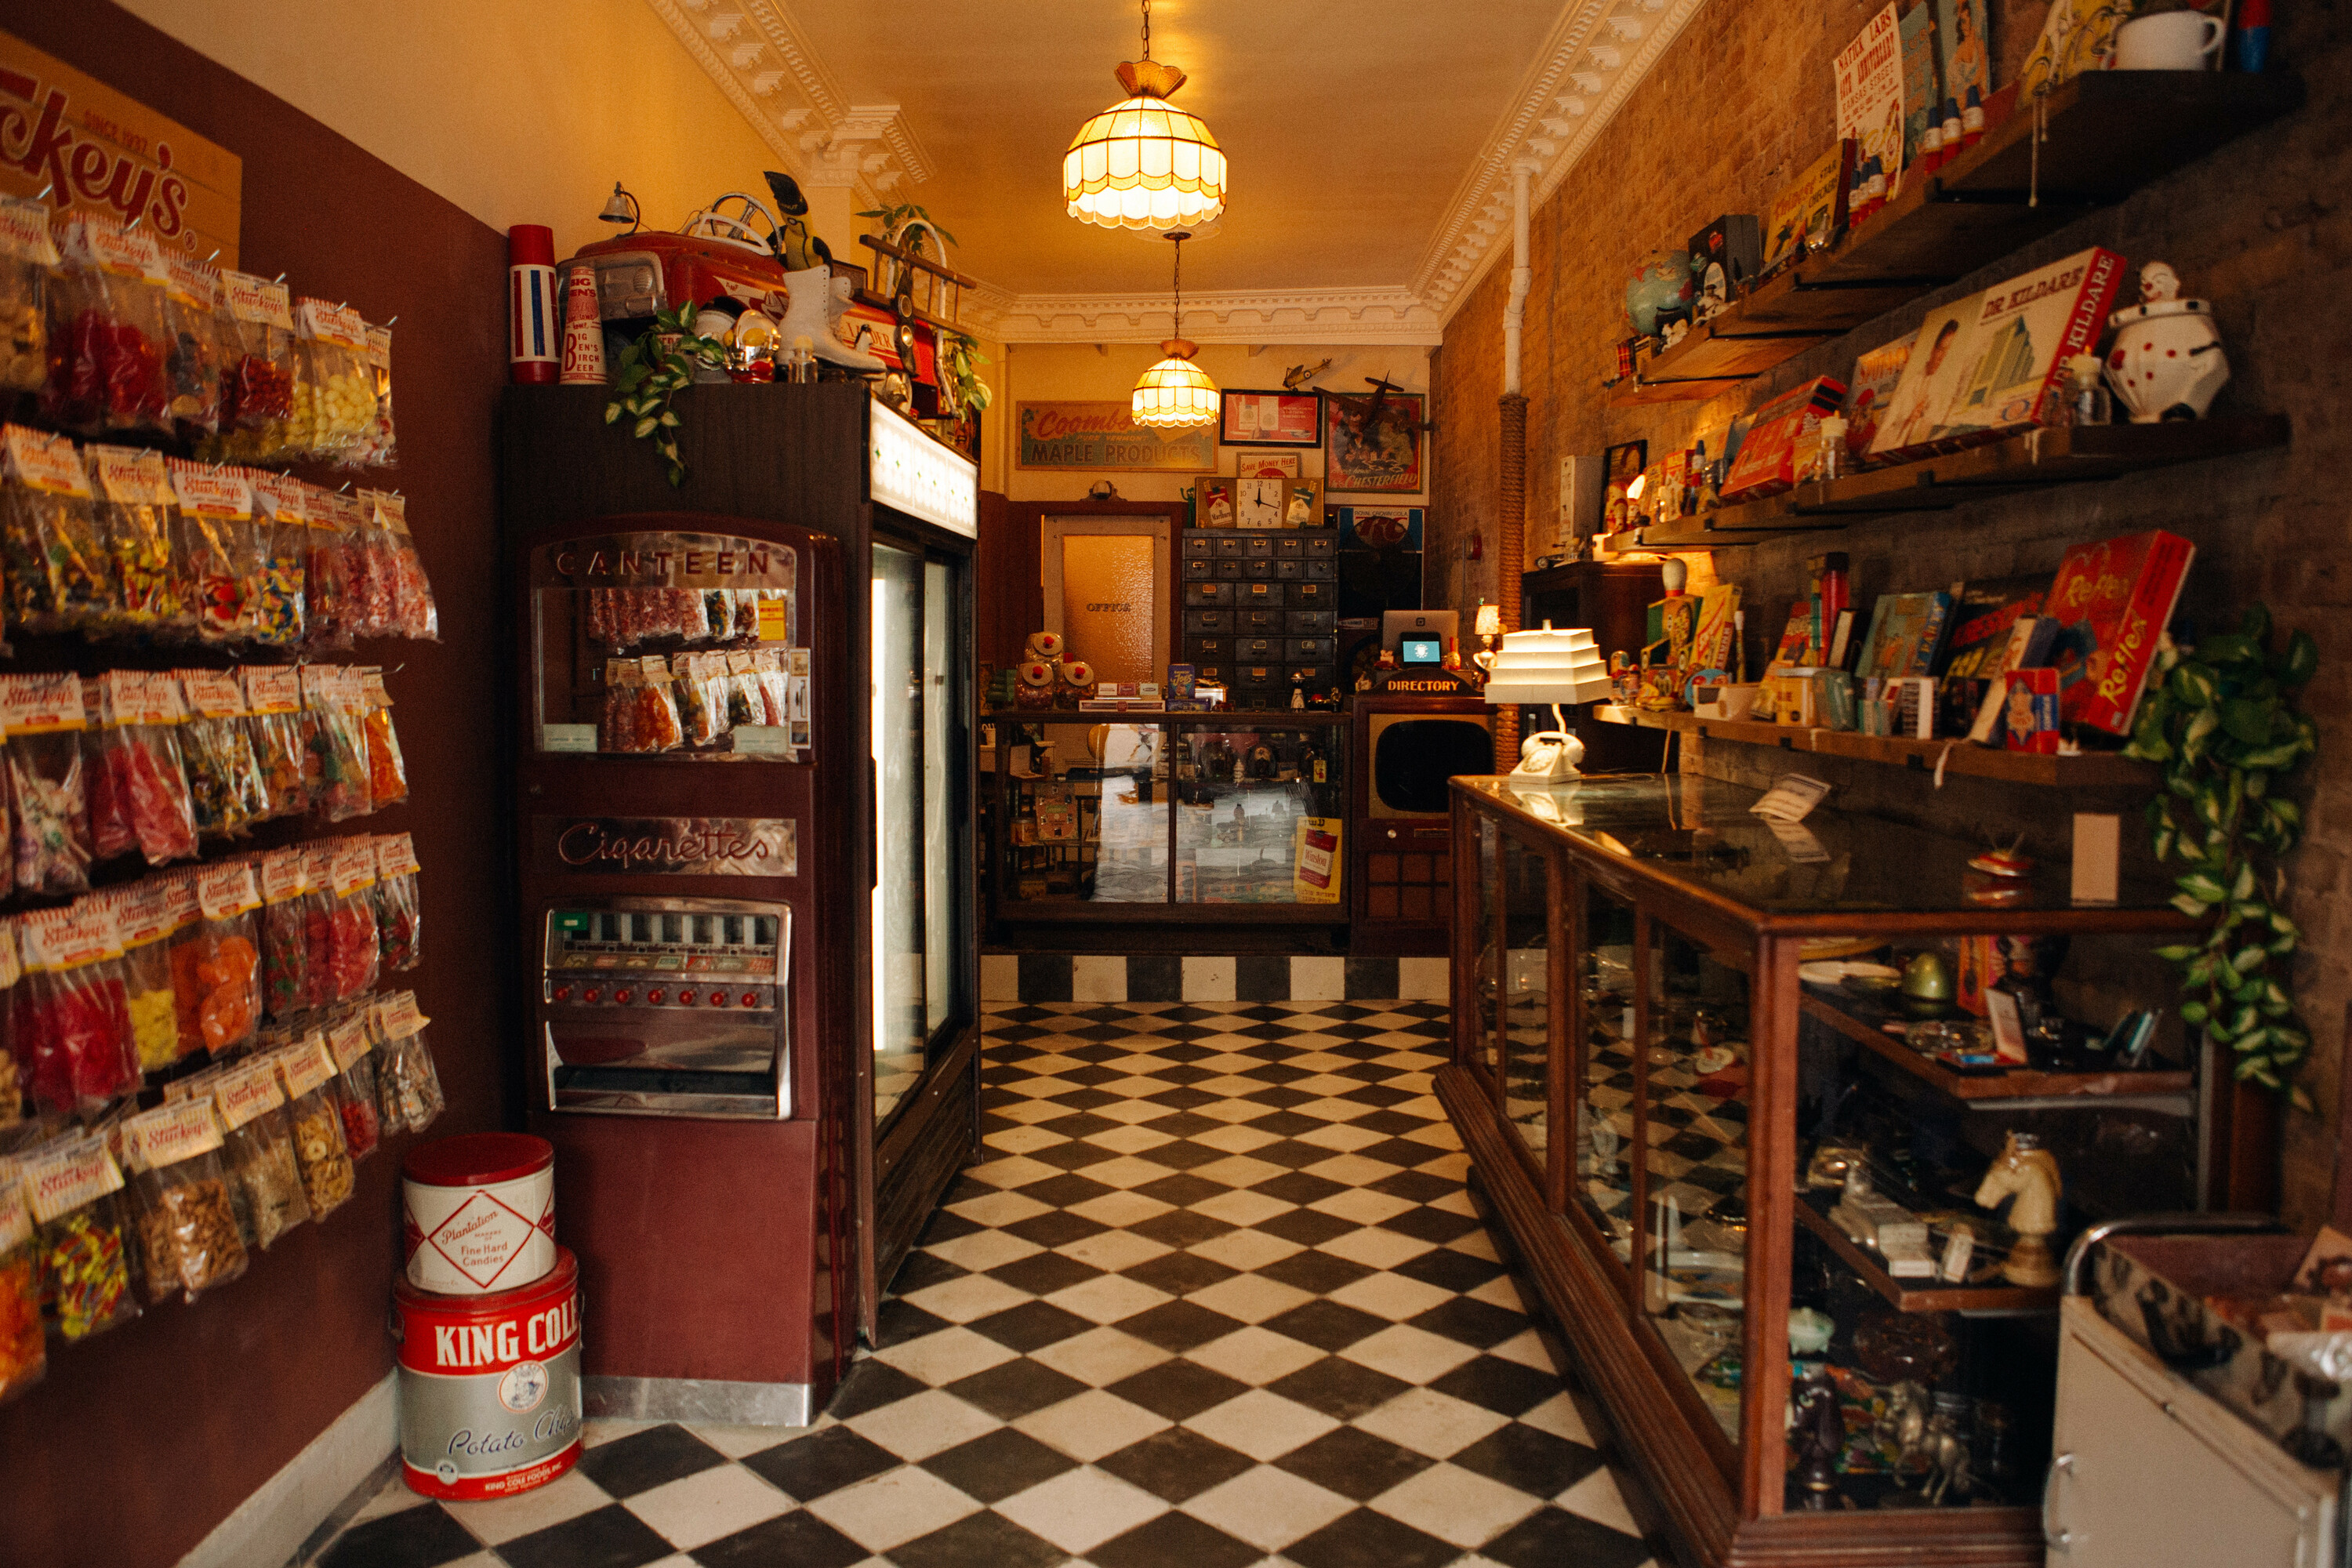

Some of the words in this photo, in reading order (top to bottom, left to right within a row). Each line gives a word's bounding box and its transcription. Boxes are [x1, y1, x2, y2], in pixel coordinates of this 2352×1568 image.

[1838, 36, 1864, 74] NATICK
[1869, 9, 1892, 43] LABS
[84, 110, 119, 139] SINCE
[725, 282, 739, 292] AMF
[2067, 254, 2115, 350] KILDARE
[1029, 443, 1094, 463] MAPLE
[1104, 444, 1201, 463] PRODUCTS
[1241, 463, 1256, 472] SAVE
[1258, 459, 1279, 469] MONEY
[1345, 473, 1418, 488] CHESTERFIELD
[1212, 510, 1232, 521] Marlboro
[556, 550, 769, 576] CANTEEN
[1086, 603, 1131, 612] OFFICE
[1387, 680, 1461, 691] DIRECTORY
[558, 822, 771, 869] Cigarettes
[1305, 848, 1328, 867] Winston
[441, 1210, 499, 1245] Plantation
[461, 1245, 481, 1256] Fine
[483, 1241, 508, 1254] Hard
[462, 1254, 504, 1267] Candies
[434, 1319, 521, 1367] KING
[448, 1429, 524, 1456] Potato
[485, 1480, 506, 1492] KING
[506, 1475, 526, 1487] COLE
